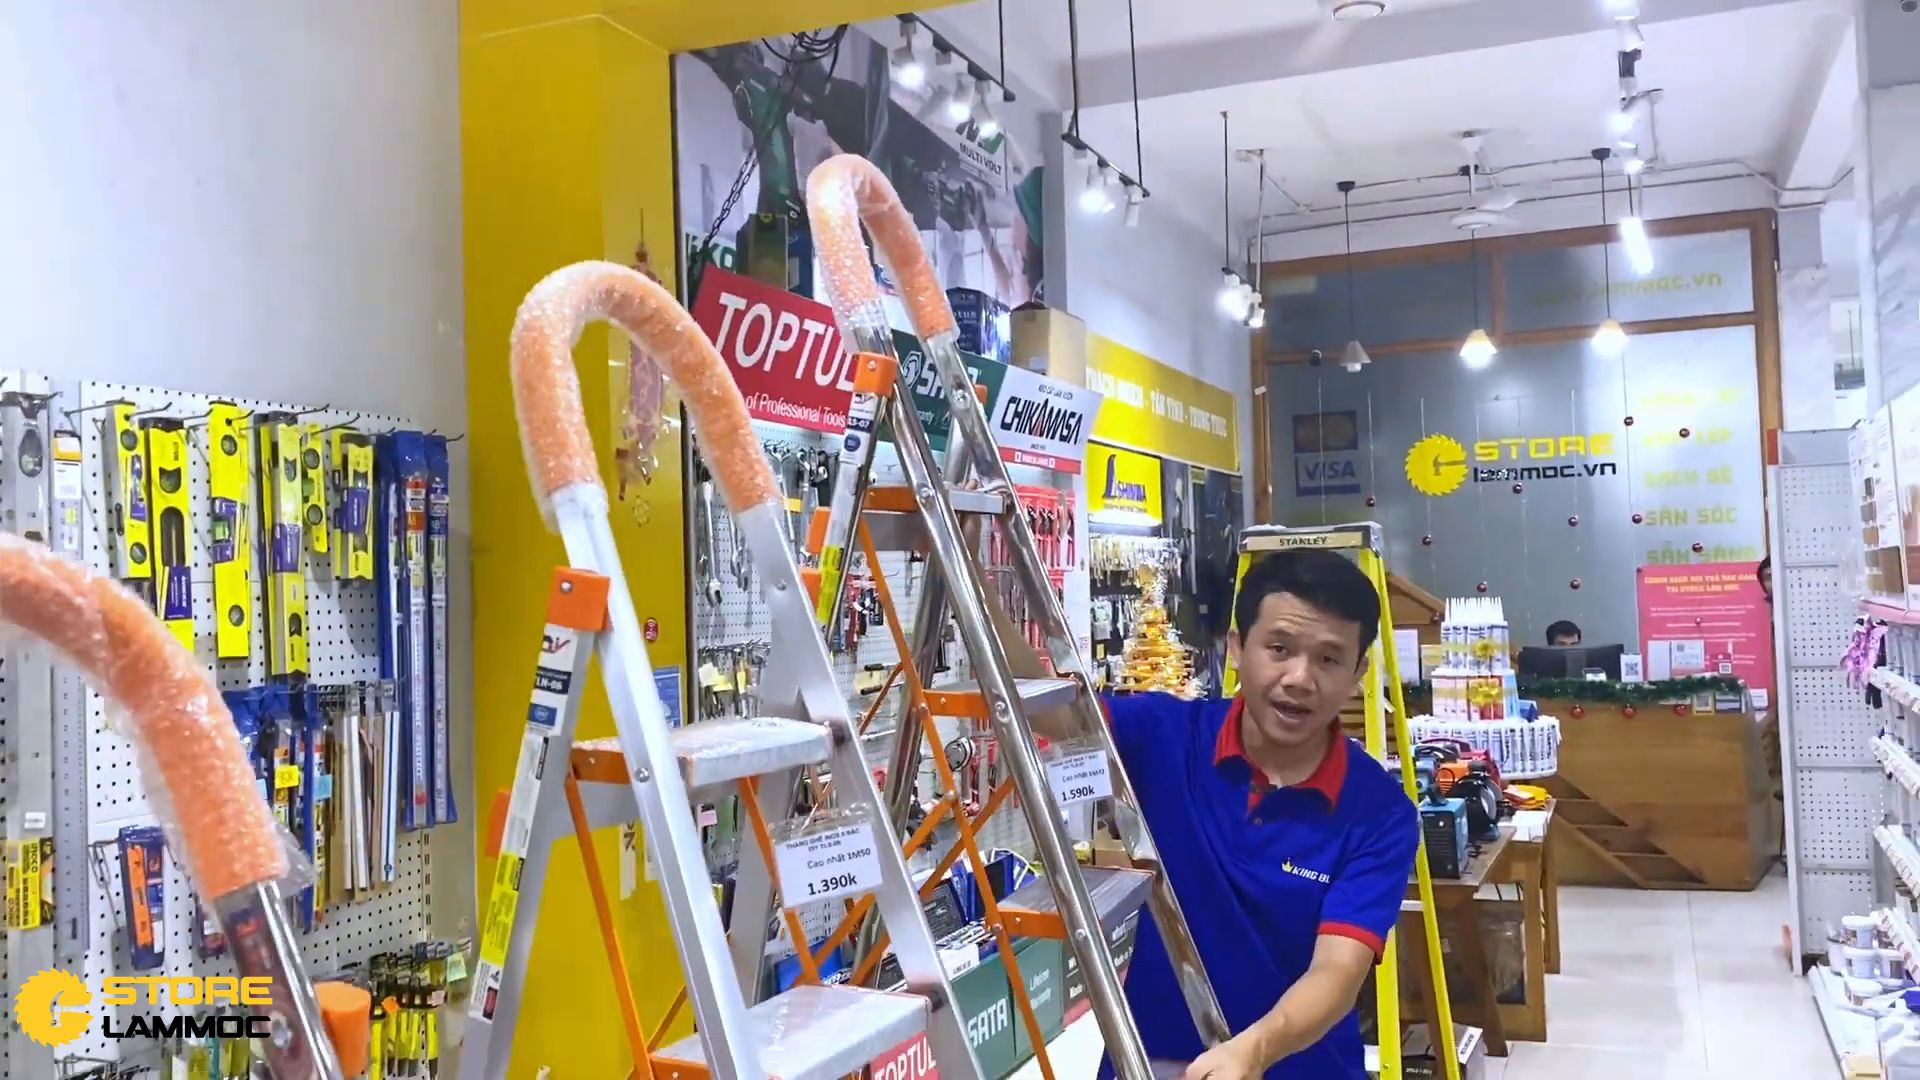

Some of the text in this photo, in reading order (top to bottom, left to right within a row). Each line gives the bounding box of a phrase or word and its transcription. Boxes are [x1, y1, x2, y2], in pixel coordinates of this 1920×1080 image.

[960, 142, 1002, 176] MULTI VOLT
[715, 292, 855, 391] TOPTUL
[746, 392, 847, 428] of Professional Tools
[1000, 396, 1083, 446] CHIKAMASA
[1473, 432, 1616, 462] STORE
[1304, 460, 1356, 481] VISA
[1279, 536, 1328, 547] STANLEY
[1062, 784, 1095, 802] 1.590k
[807, 860, 824, 869] Cao
[847, 848, 871, 860] 1M50
[807, 872, 857, 896] 1.390k
[1292, 866, 1319, 880] KING
[967, 998, 1008, 1048] SATA
